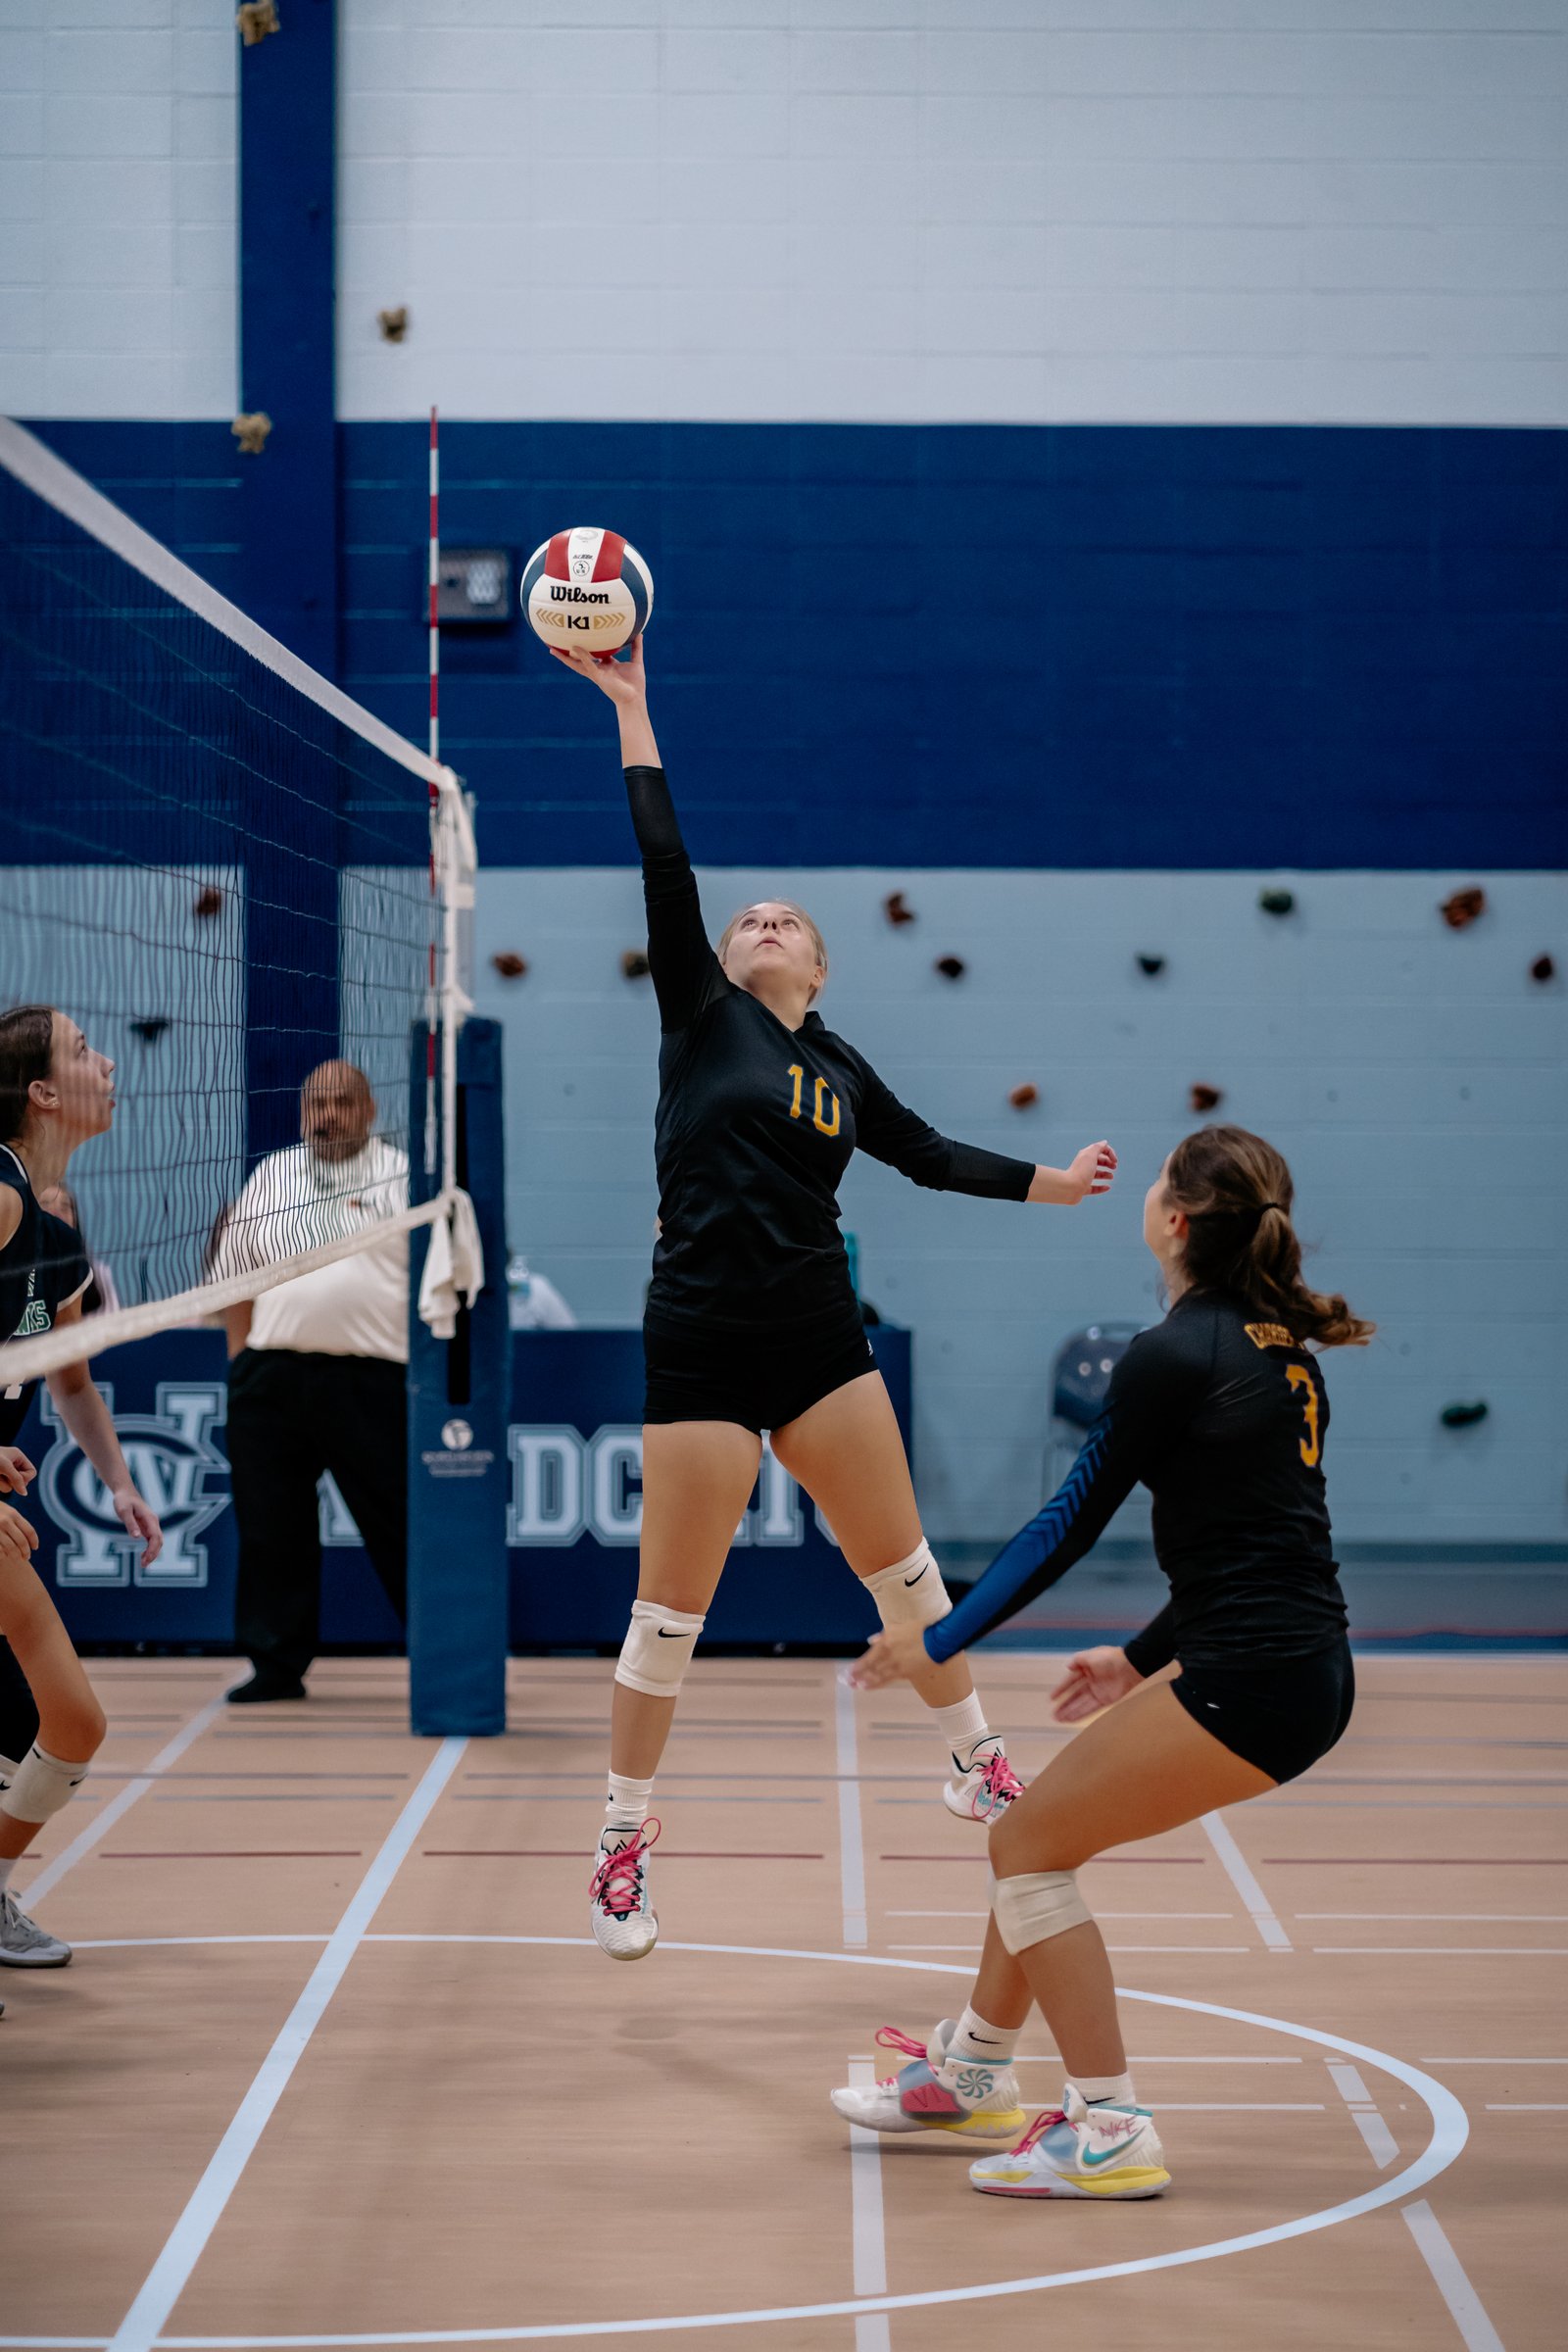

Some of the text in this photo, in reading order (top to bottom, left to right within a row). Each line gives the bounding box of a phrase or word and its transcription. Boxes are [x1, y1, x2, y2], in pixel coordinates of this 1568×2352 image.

[550, 585, 610, 604] Wilson
[567, 614, 590, 629] K1
[788, 1063, 840, 1137] 10
[1285, 1364, 1319, 1467] 3
